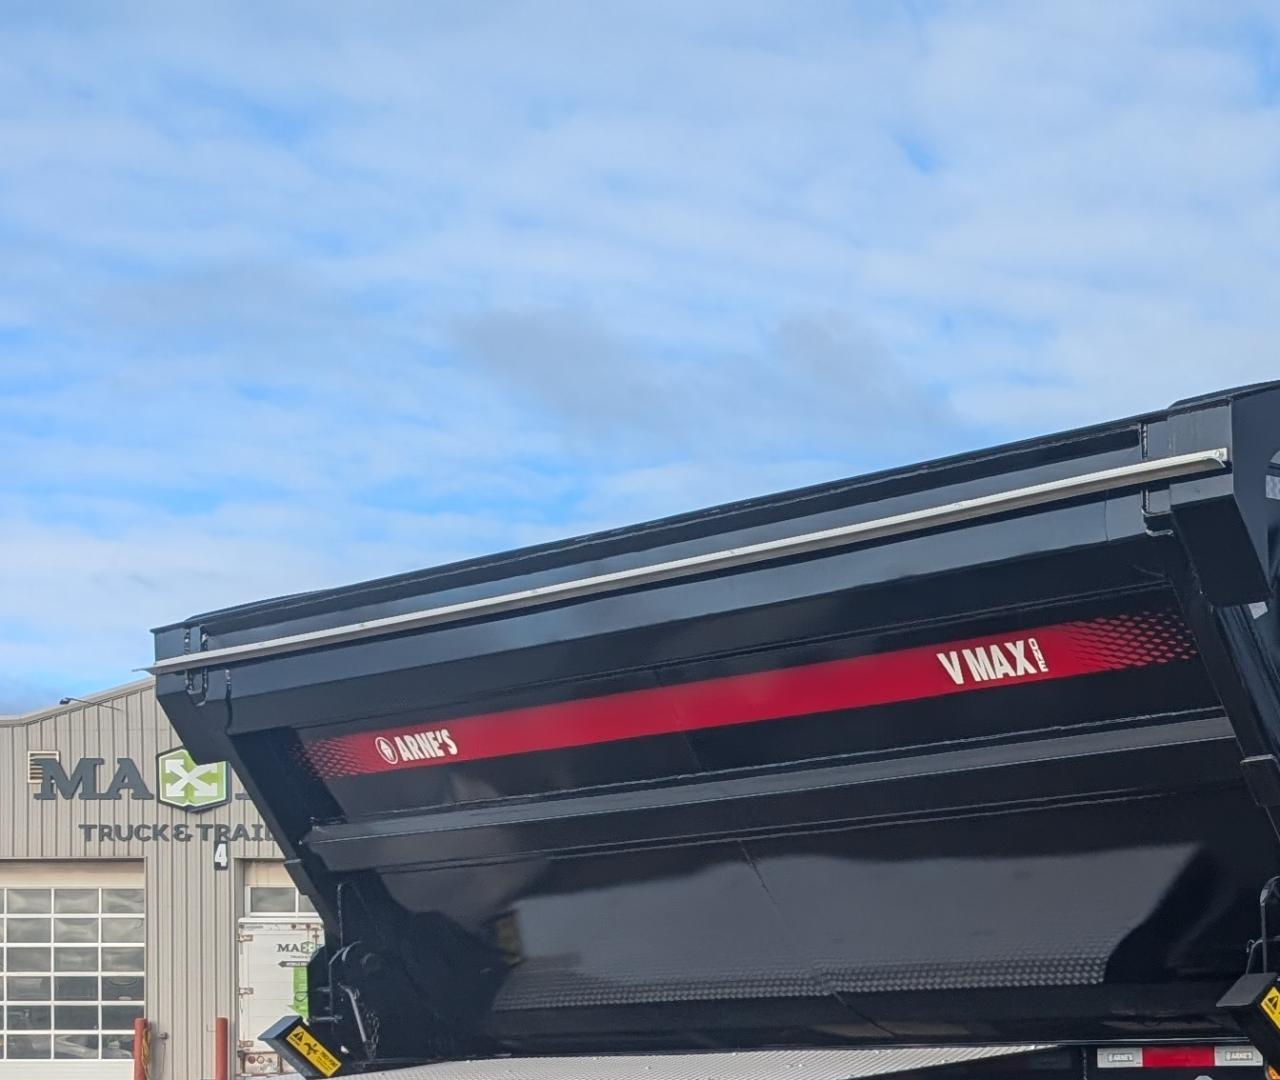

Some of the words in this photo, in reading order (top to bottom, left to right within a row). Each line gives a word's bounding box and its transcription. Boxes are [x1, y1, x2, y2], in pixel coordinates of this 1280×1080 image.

[936, 651, 965, 685] V
[962, 640, 1037, 682] MAX
[1028, 637, 1048, 672] ONE
[394, 728, 458, 762] ARNE'S
[79, 823, 170, 842] TRUCK
[172, 823, 193, 842] &
[214, 842, 229, 869] 4
